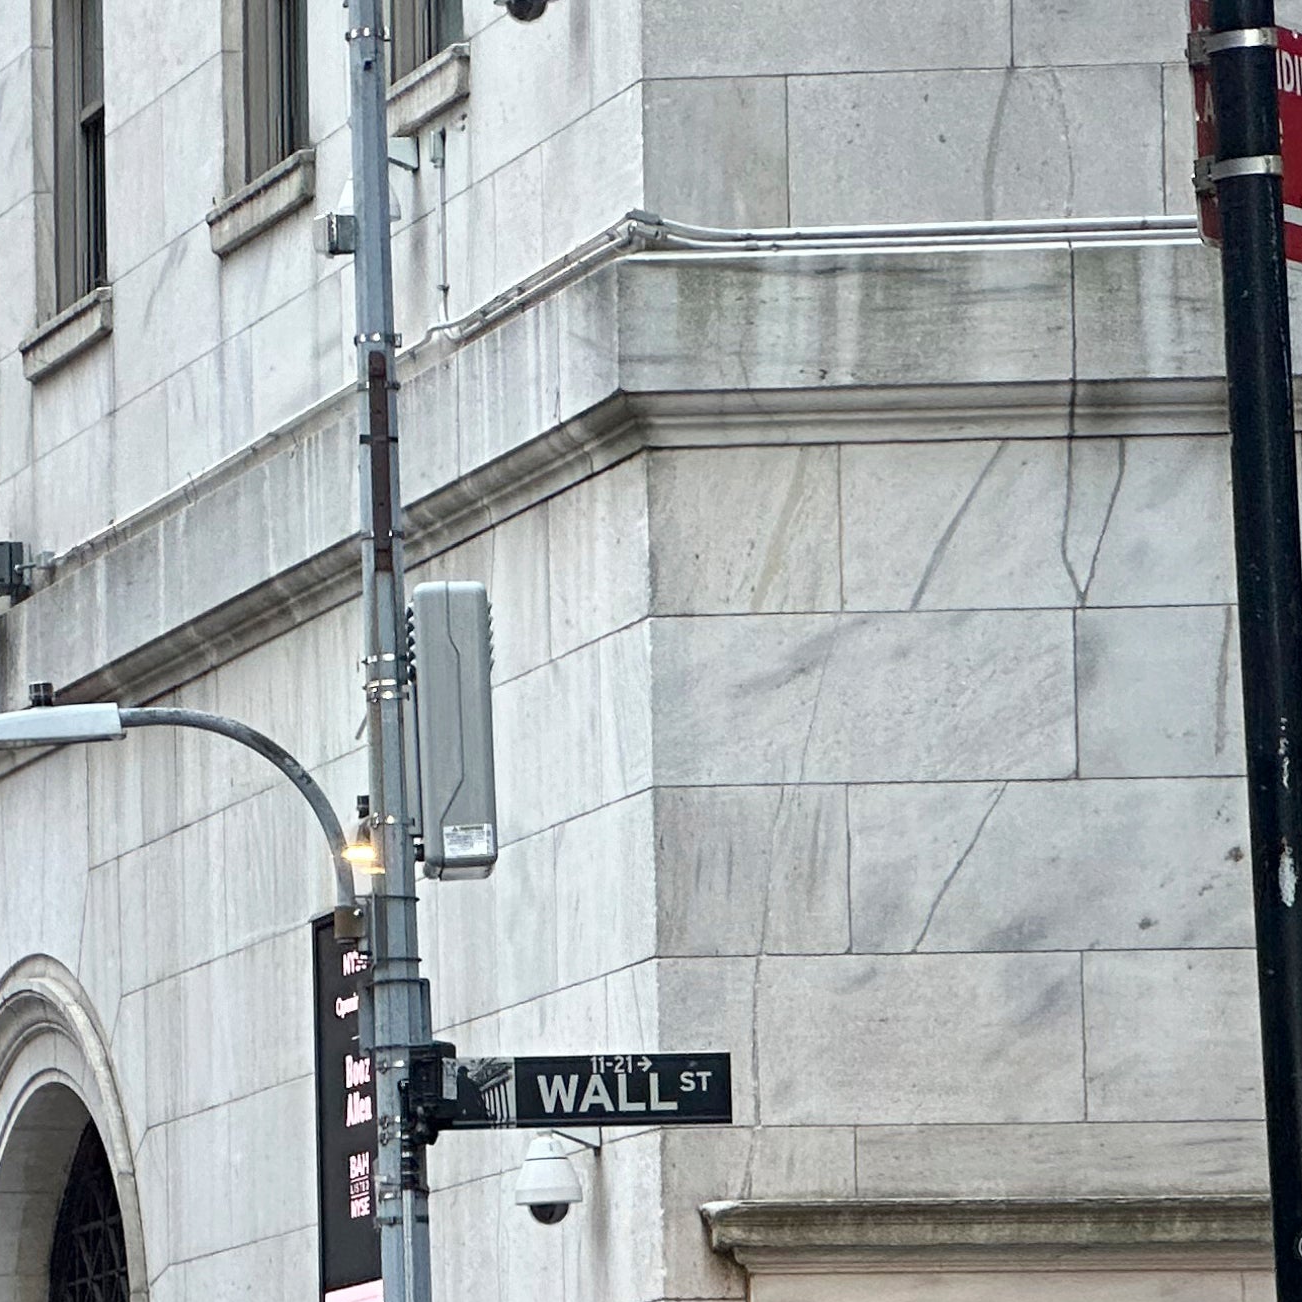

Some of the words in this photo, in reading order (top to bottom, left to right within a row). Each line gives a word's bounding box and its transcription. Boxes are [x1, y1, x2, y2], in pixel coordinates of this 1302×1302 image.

[345, 1055, 371, 1089] Booz
[590, 1055, 633, 1074] 11-21
[537, 1072, 678, 1113] WALL
[679, 1071, 712, 1092] ST
[346, 1091, 373, 1128] Allen
[349, 1151, 370, 1179] BAH
[350, 1196, 371, 1219] NYSE
